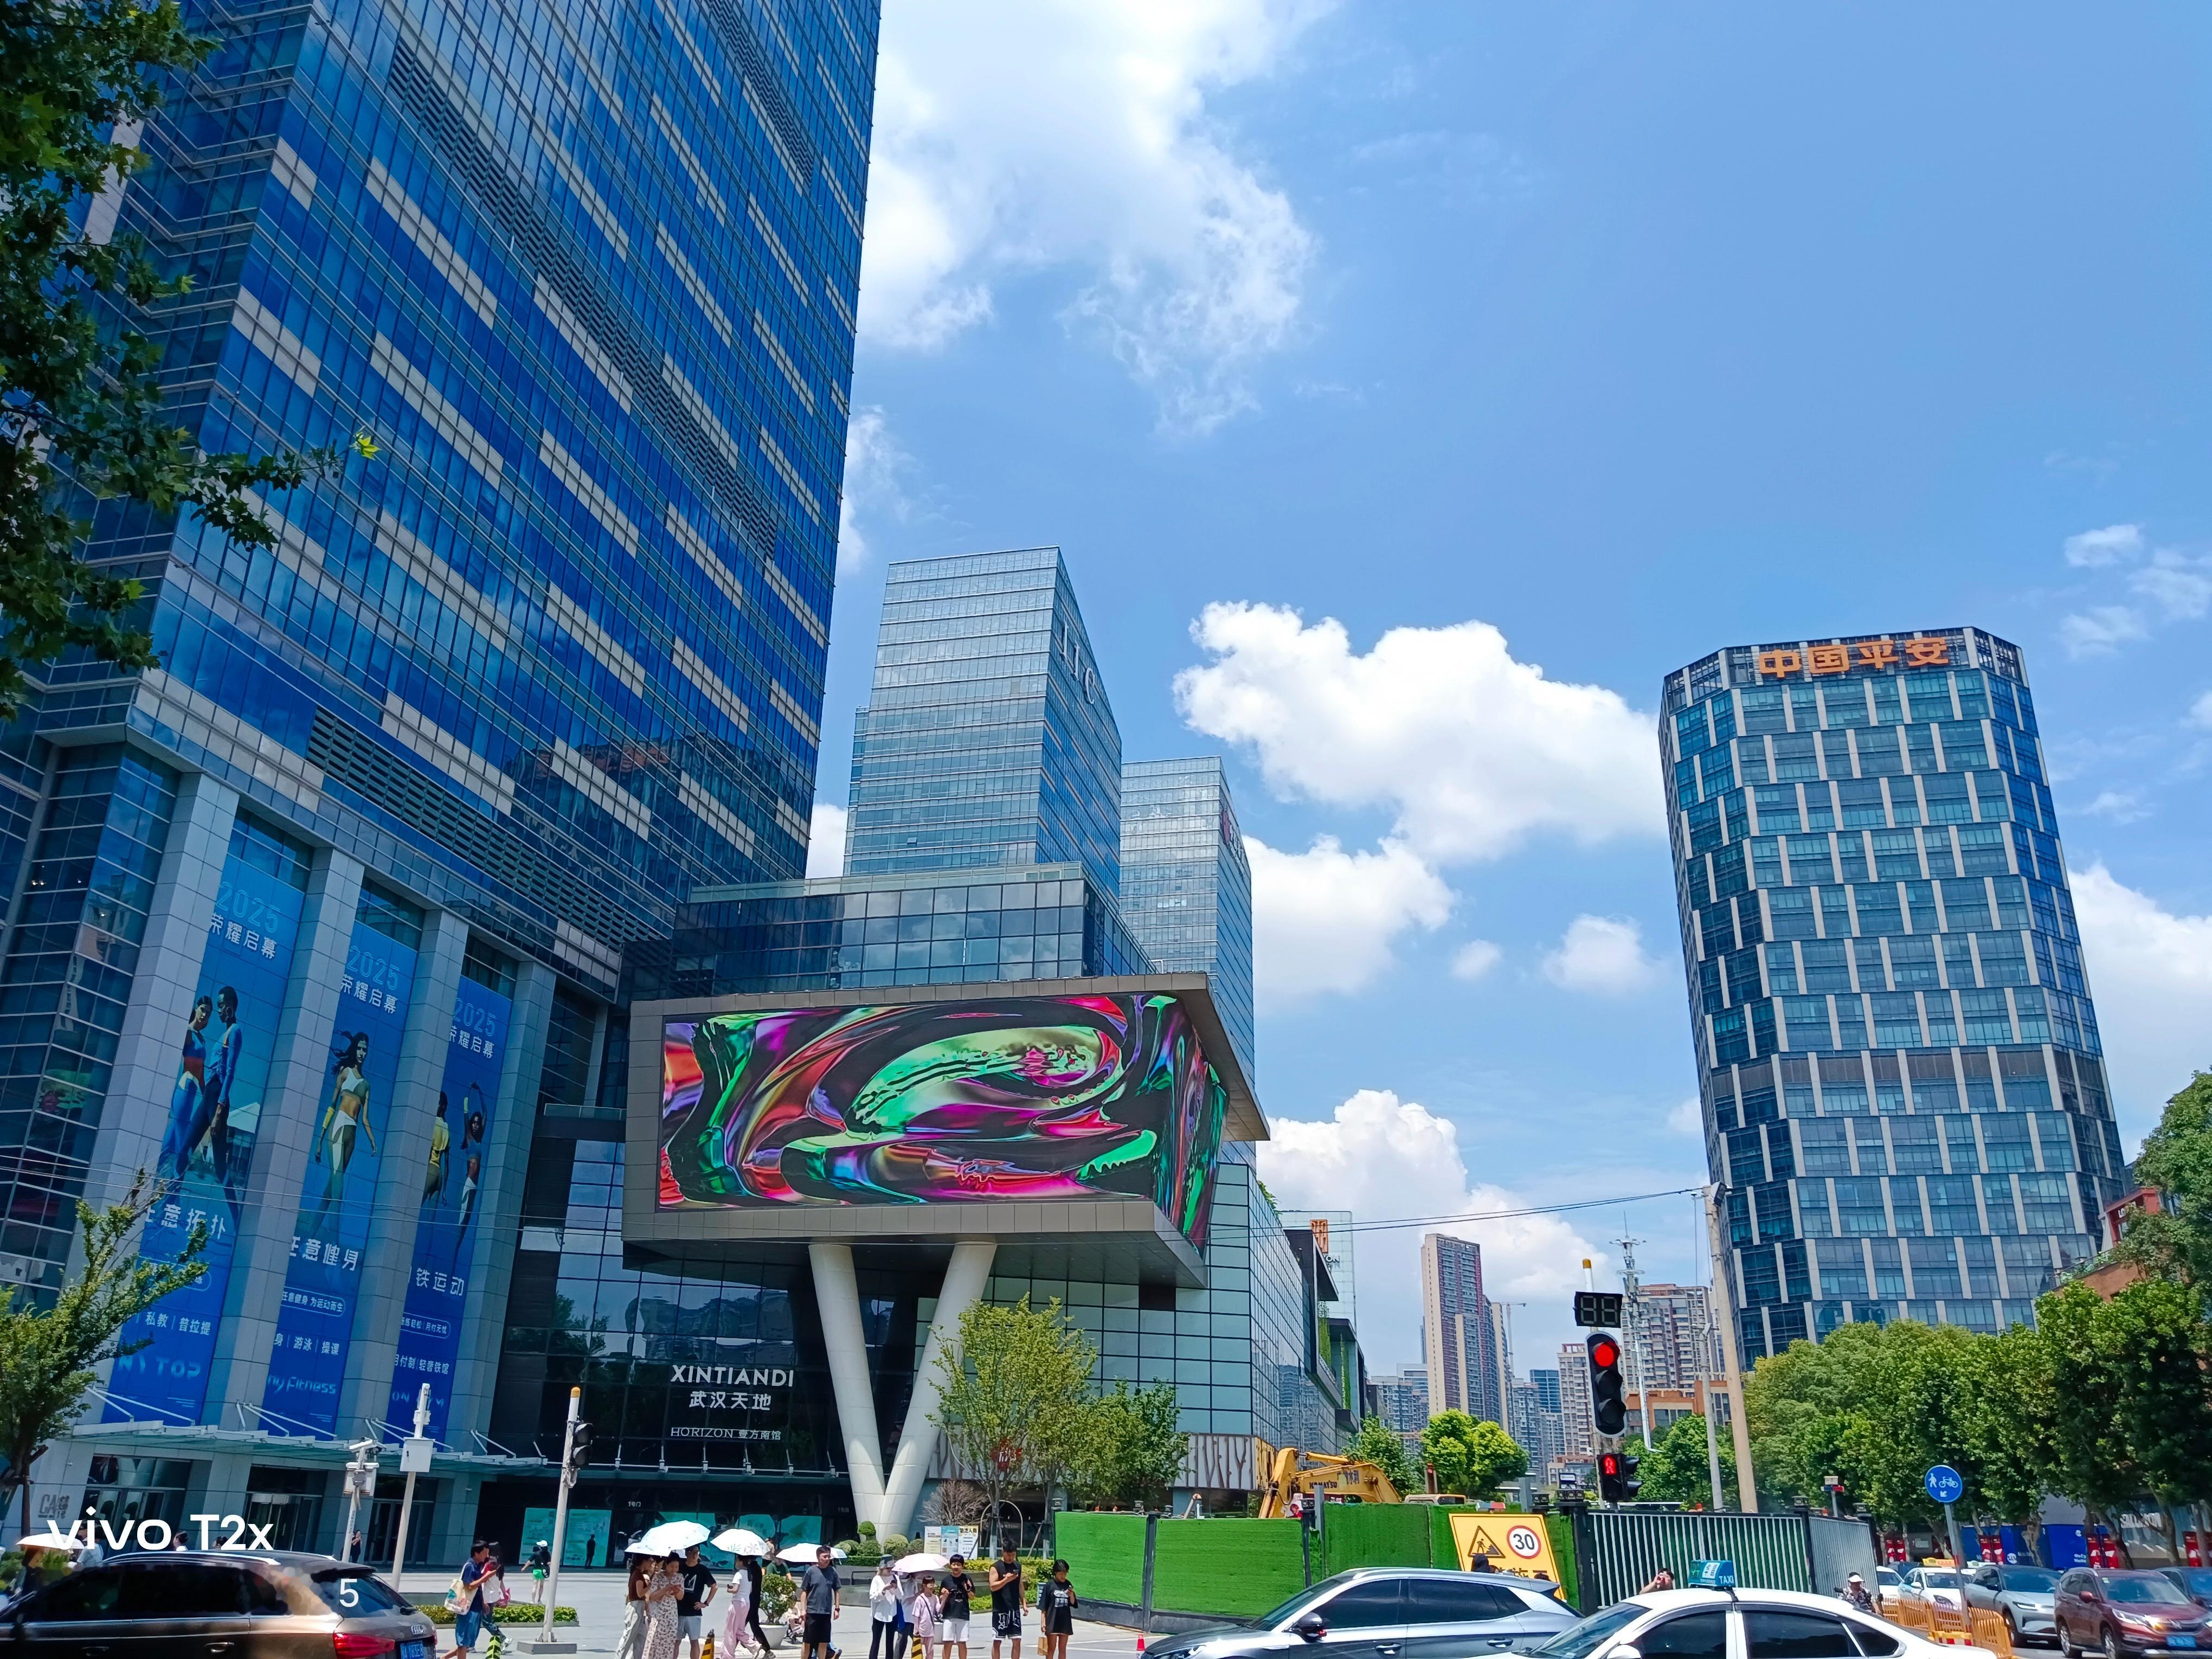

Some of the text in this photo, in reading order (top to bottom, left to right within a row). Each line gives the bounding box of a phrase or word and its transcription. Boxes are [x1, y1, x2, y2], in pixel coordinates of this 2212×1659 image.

[1759, 636, 1951, 678] 中国平安
[216, 882, 280, 933] 2025
[210, 912, 277, 959] 荣耀启幕
[346, 946, 400, 990] 2025
[341, 974, 398, 1014] 荣耀启幕
[453, 998, 496, 1037] 2025
[1324, 1255, 1340, 1263] ON
[408, 1266, 465, 1296] 铁运动
[145, 1311, 212, 1335] 私教 普拉提
[293, 1336, 313, 1351] 游泳
[321, 1341, 340, 1356] 操课
[156, 1356, 201, 1380] TOP
[670, 1365, 794, 1387] XINTIANDI
[689, 1391, 772, 1411] 武汉天地
[671, 1427, 733, 1438] HORIZON
[1513, 1533, 1536, 1551] 30
[1719, 1575, 1734, 1585] TAXI
